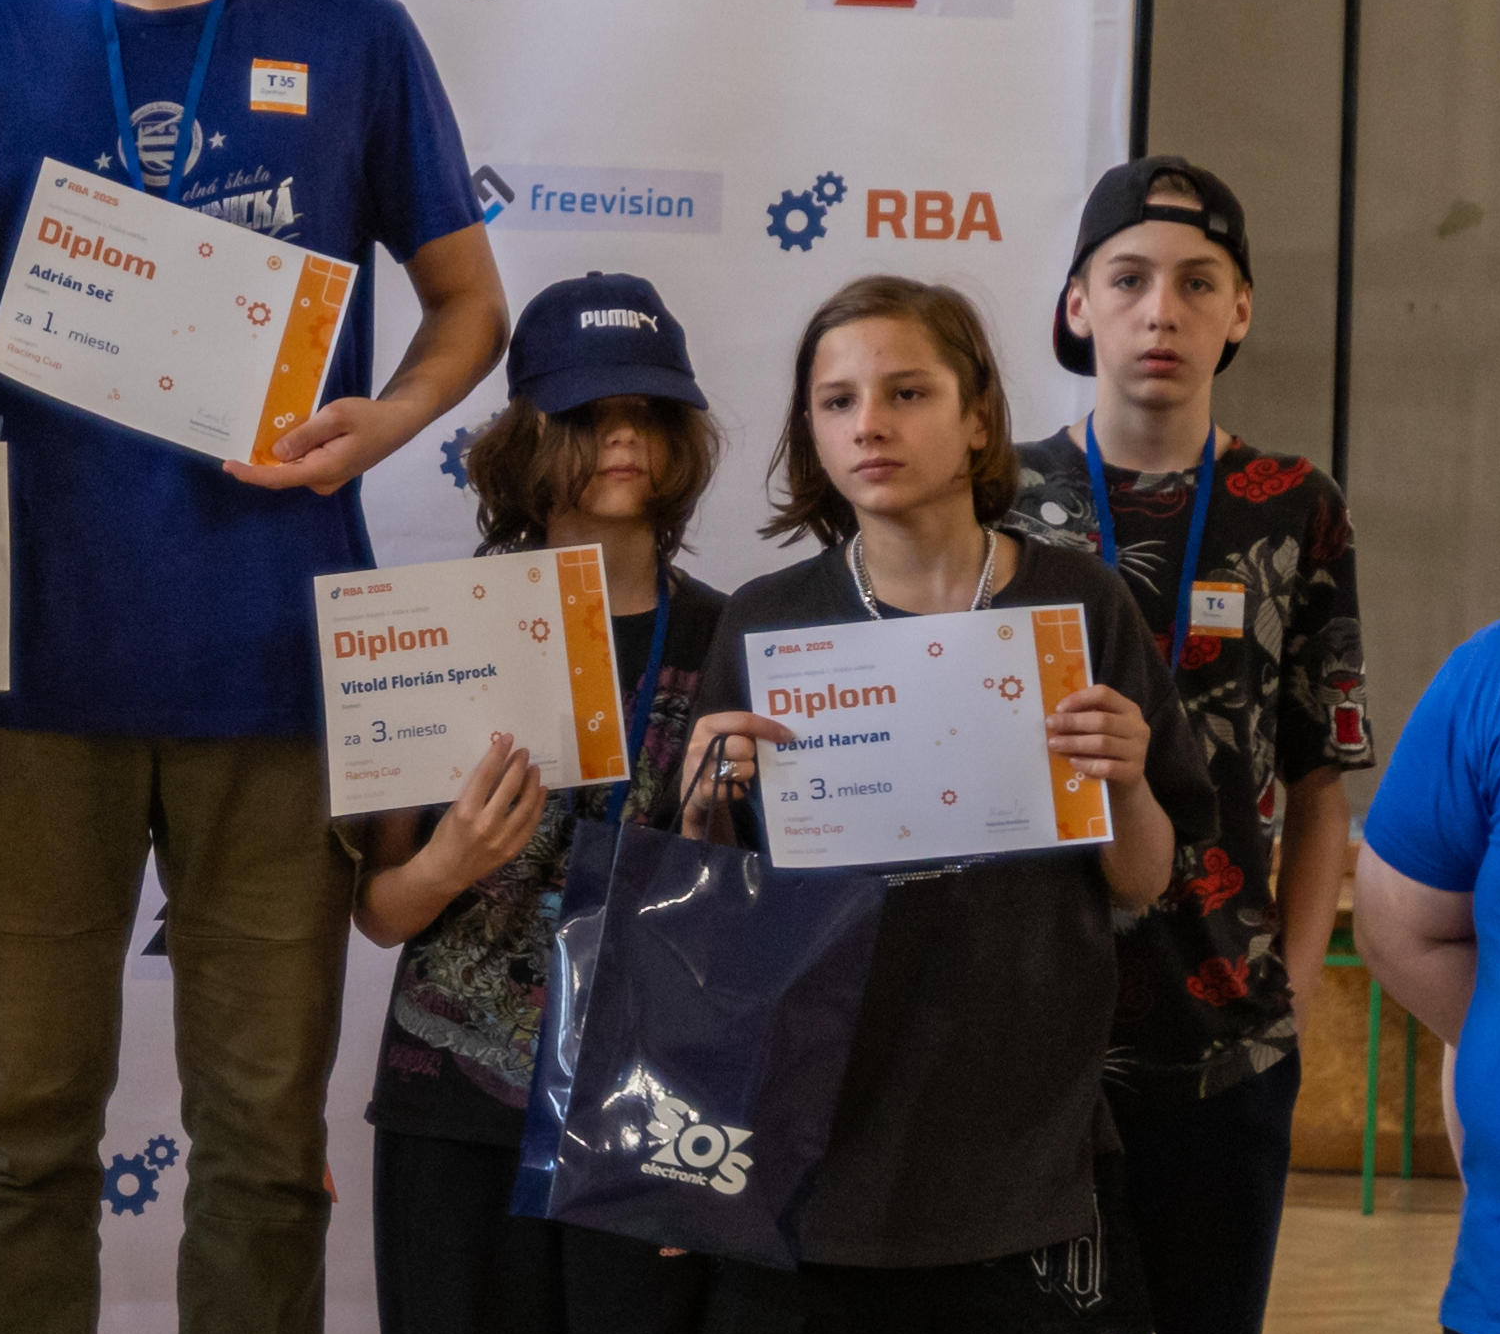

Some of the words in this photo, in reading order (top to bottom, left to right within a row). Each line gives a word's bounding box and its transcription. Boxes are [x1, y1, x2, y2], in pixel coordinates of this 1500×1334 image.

[67, 181, 90, 197] RBA
[92, 190, 119, 207] 2025
[529, 184, 695, 219] freevision
[865, 188, 1004, 242] RBA
[37, 216, 157, 280] Diplom
[29, 264, 83, 293] Adrián
[85, 283, 115, 303] Seč
[580, 309, 641, 329] PUMA
[15, 311, 33, 325] za
[42, 311, 58, 335] 1.
[68, 329, 120, 355] miesto
[6, 343, 42, 364] Racing
[42, 356, 63, 371] Cup
[343, 586, 364, 597] RBA
[367, 582, 393, 594] 2025
[333, 625, 449, 662] Diplom
[778, 644, 802, 655] RBA
[805, 640, 834, 652] 2025
[340, 677, 388, 695] Vitold
[391, 671, 445, 689] Florián
[447, 663, 498, 685] Sprock
[767, 683, 897, 719] Diplom
[344, 734, 362, 746] za
[371, 720, 394, 744] 3.
[397, 723, 448, 740] miesto
[829, 730, 891, 748] Harvan
[345, 769, 380, 782] Racing
[381, 766, 402, 779] Cup
[780, 791, 799, 803] za
[810, 777, 834, 800] 3.
[837, 781, 893, 798] miesto
[784, 825, 821, 836] Racing
[822, 823, 844, 835] Cup
[640, 1163, 709, 1186] electronic
